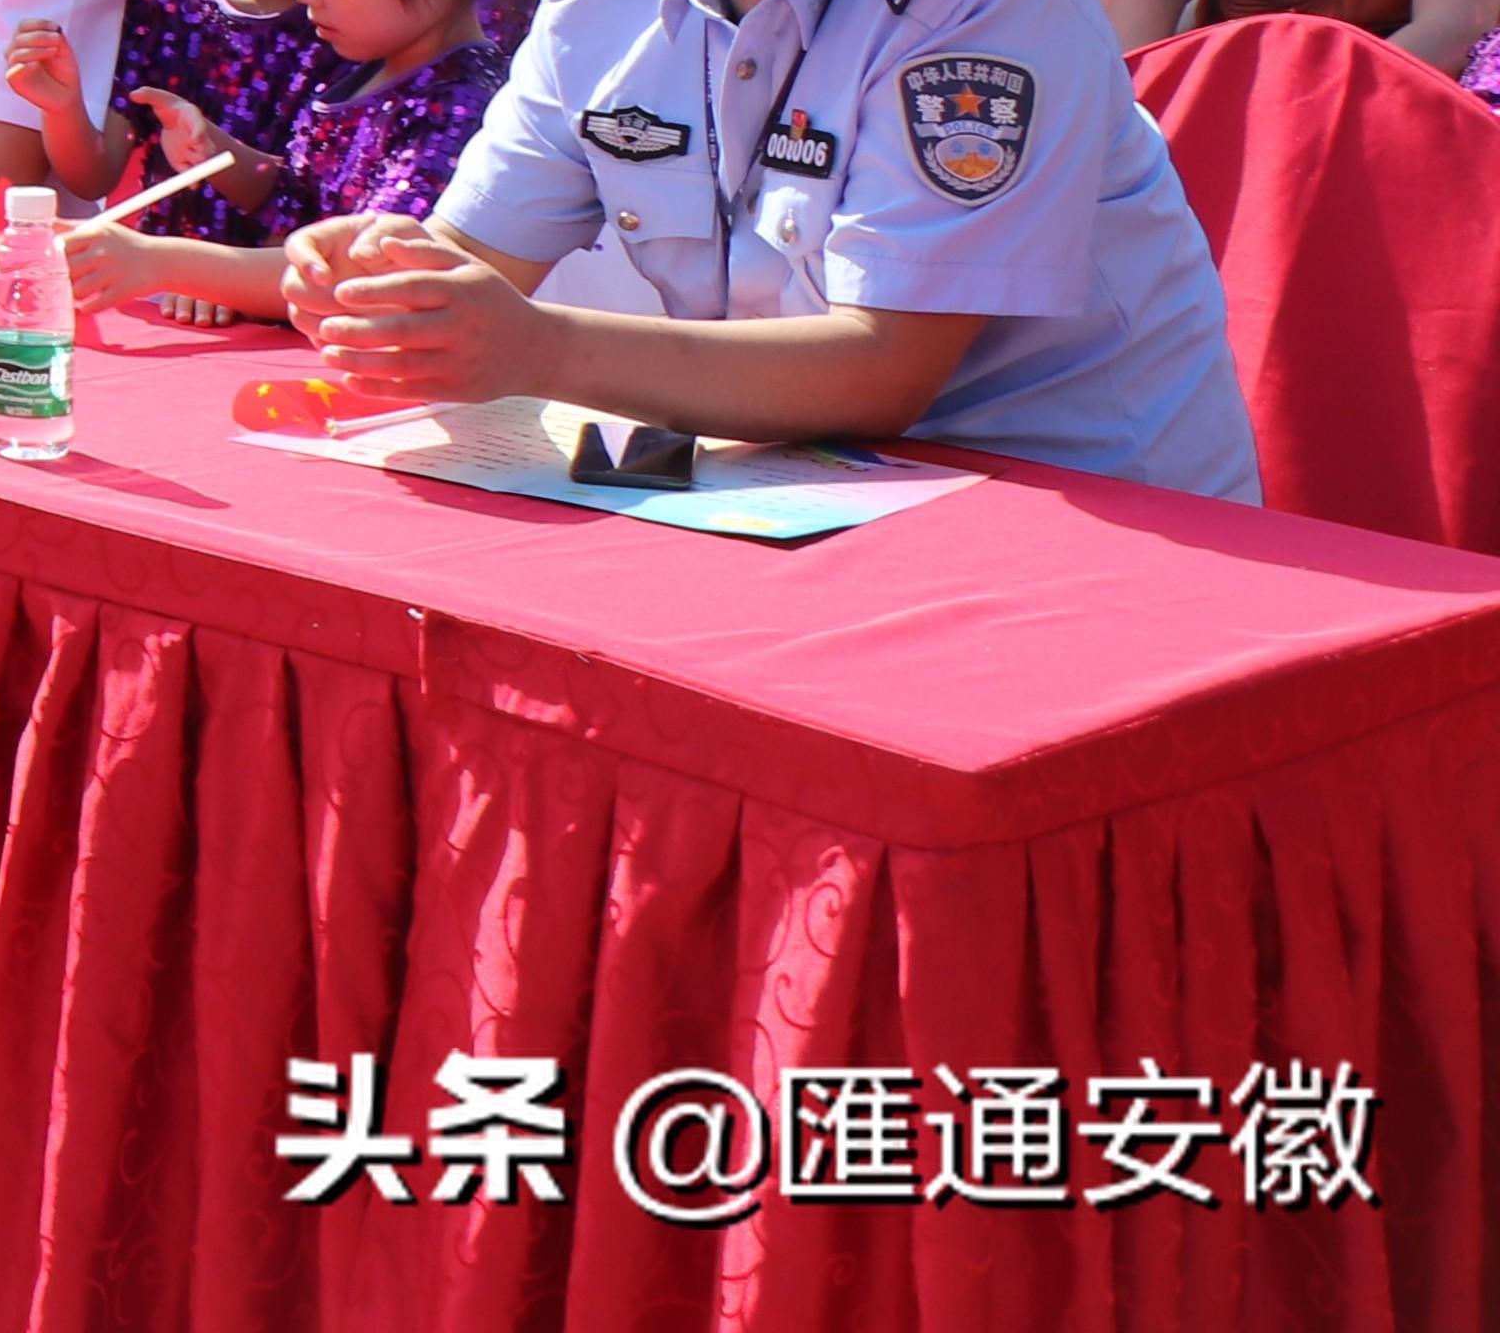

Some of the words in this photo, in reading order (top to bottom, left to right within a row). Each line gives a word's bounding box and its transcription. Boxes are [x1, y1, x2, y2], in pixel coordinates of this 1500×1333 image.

[906, 61, 1025, 95] 中华人民共和国
[915, 93, 946, 123] 警
[989, 96, 1018, 125] 察
[943, 121, 995, 137] POLICE
